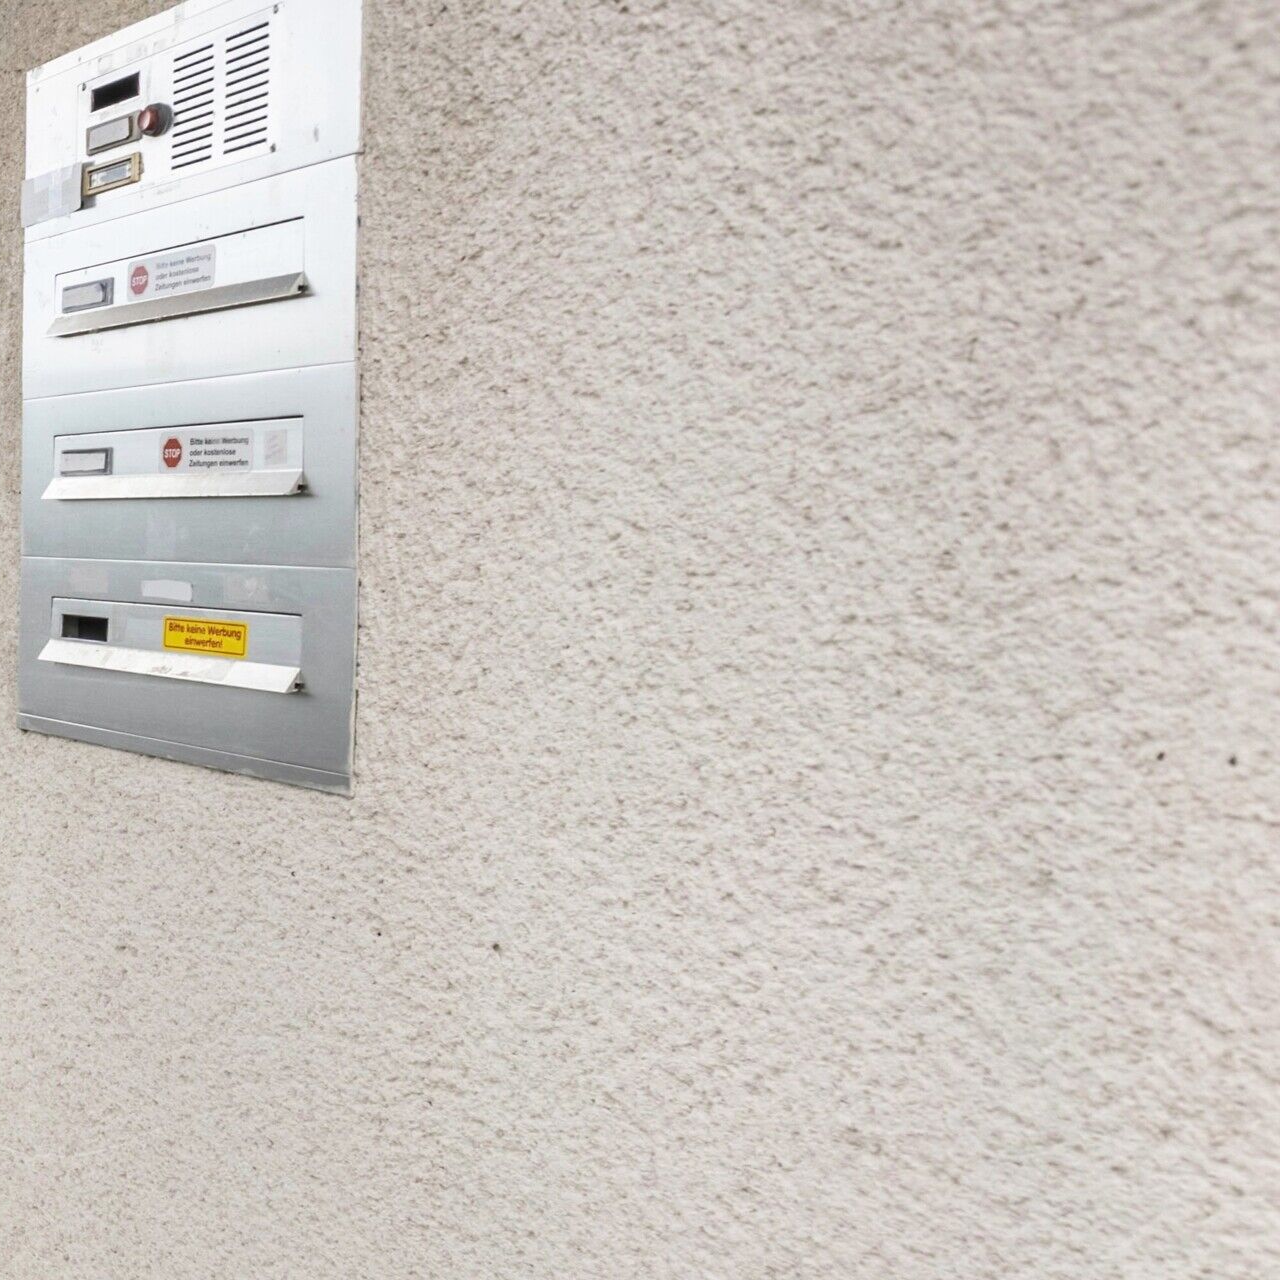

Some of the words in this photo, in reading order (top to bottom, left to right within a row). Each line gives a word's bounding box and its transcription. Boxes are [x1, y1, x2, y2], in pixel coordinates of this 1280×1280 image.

[132, 274, 148, 287] STOP
[189, 437, 203, 446] Bitte
[222, 437, 249, 446] Werbung
[164, 448, 181, 458] STOP
[203, 448, 236, 456] kostenlose
[189, 459, 218, 468] Zeitungen
[168, 622, 185, 633] Bitte
[186, 624, 206, 634] keine
[207, 626, 242, 640] Werbung
[184, 636, 223, 648] einwerfen!
